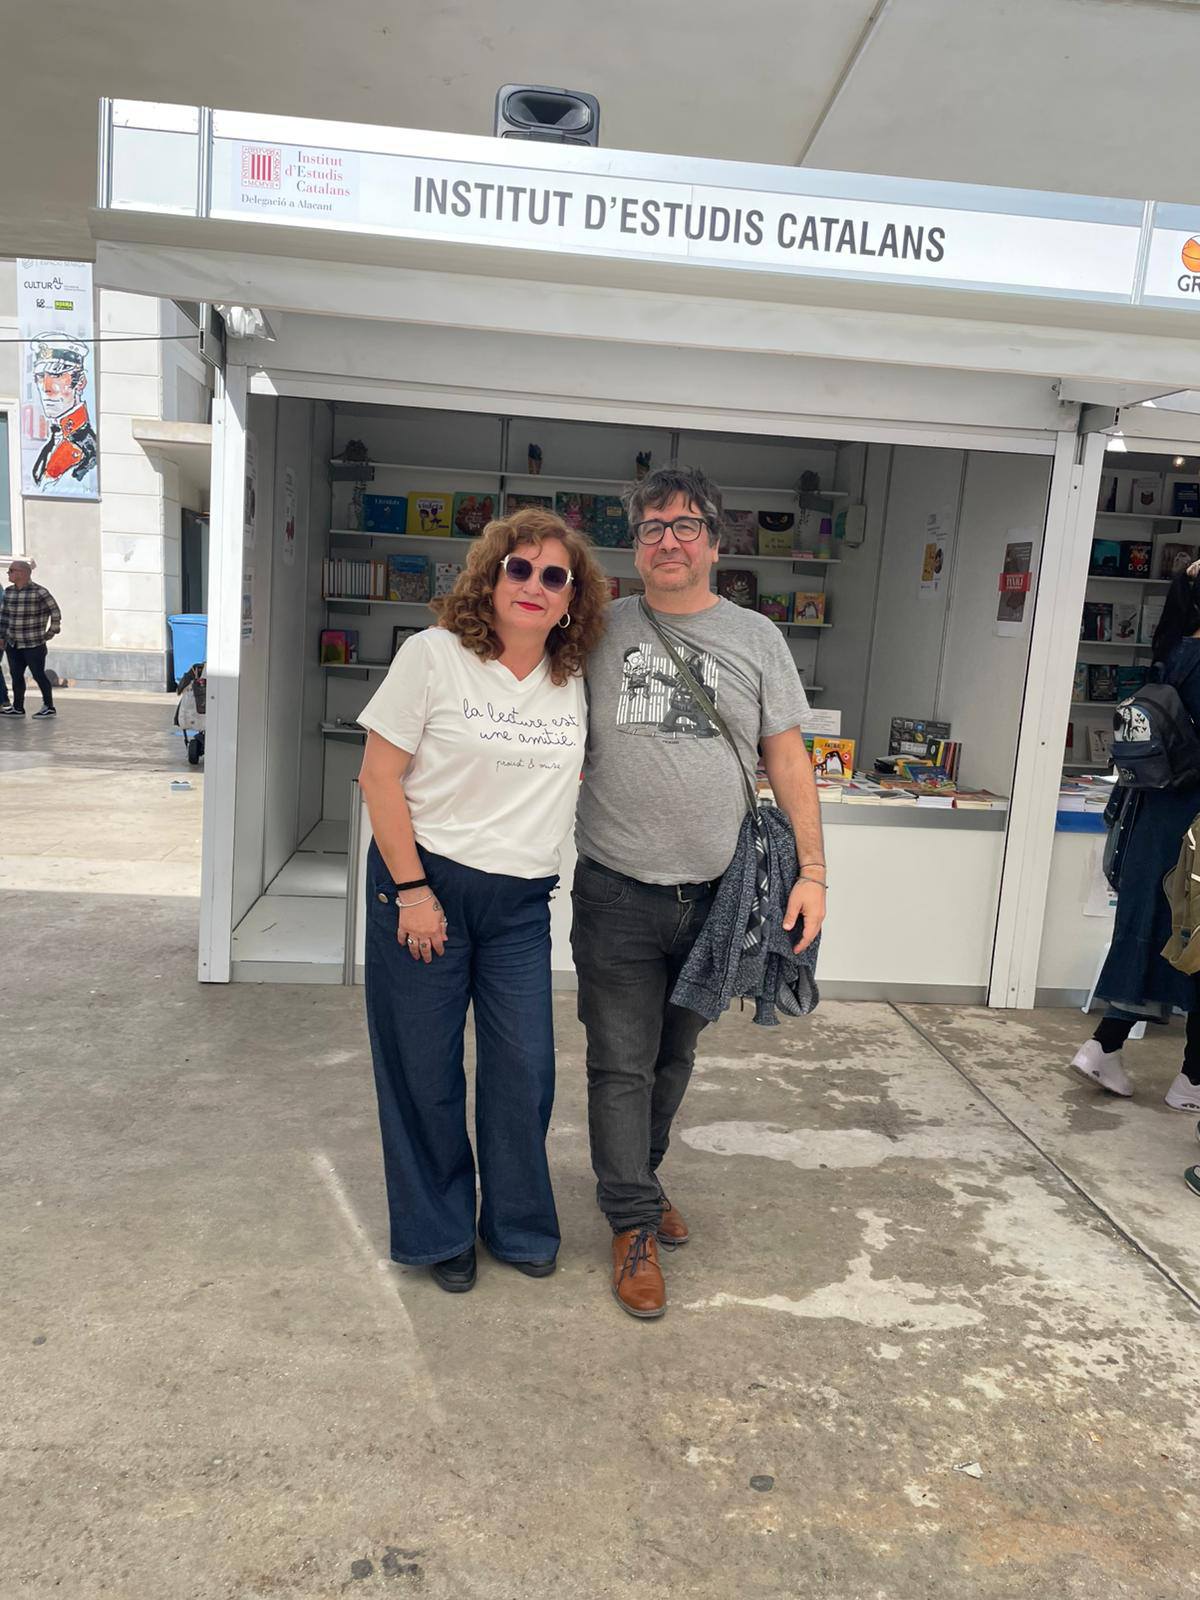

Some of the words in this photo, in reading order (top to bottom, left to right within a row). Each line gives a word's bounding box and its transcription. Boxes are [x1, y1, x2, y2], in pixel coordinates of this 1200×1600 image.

[298, 151, 343, 167] Institut
[285, 165, 344, 181] d'Estudis
[297, 180, 351, 197] Catalans
[241, 194, 287, 208] Delegació
[297, 200, 333, 211] Alacant
[414, 176, 573, 227] INSTITUT
[584, 194, 765, 246] D'ESTUDIS
[777, 213, 946, 262] CATALANS
[463, 698, 483, 719] la
[487, 702, 547, 728] lecture
[552, 714, 579, 727] est
[480, 731, 512, 740] une
